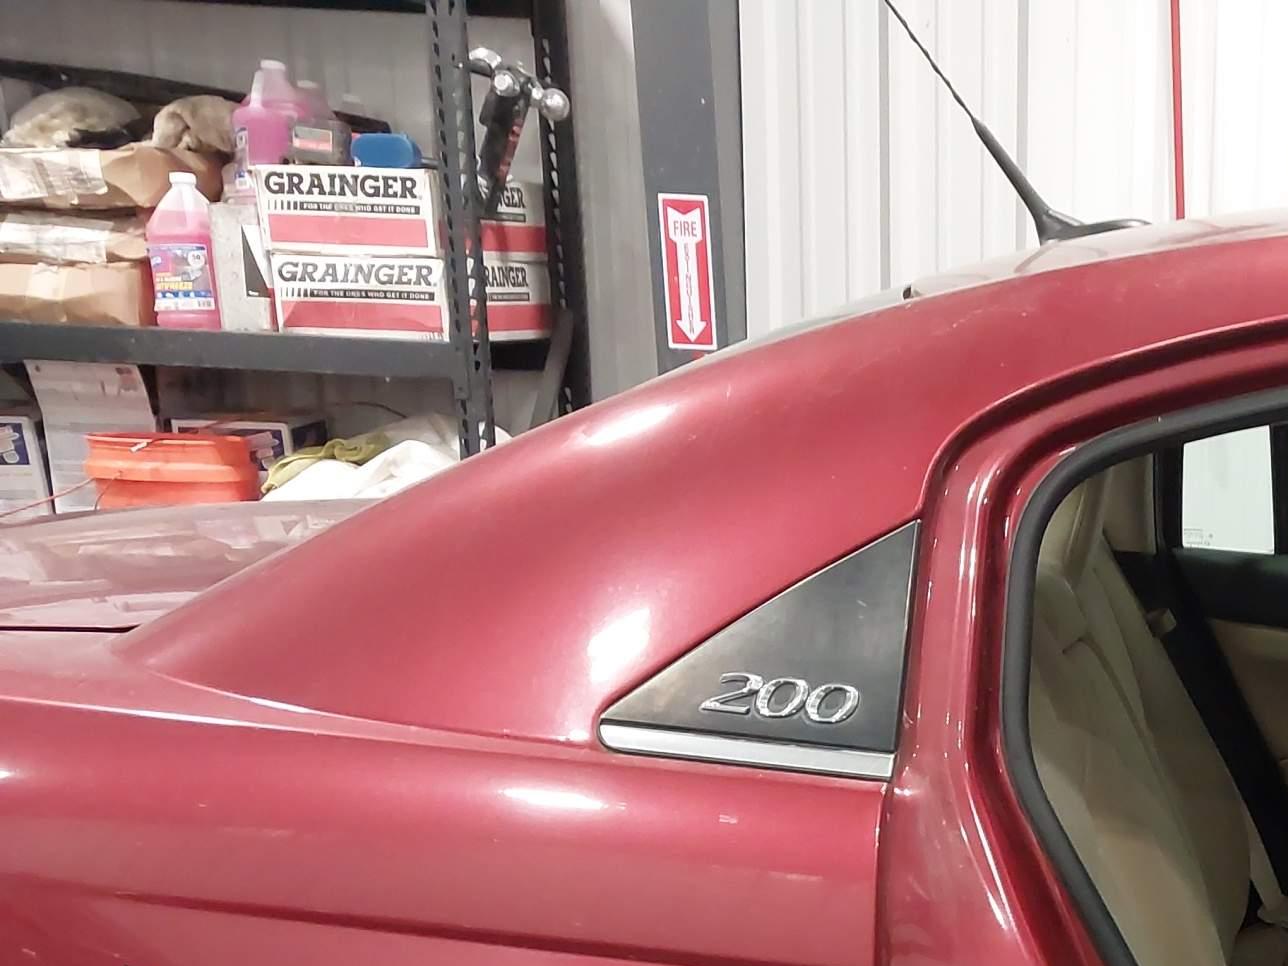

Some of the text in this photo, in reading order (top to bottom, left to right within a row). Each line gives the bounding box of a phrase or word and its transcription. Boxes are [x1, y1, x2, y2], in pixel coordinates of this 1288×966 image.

[264, 171, 417, 199] GRAINGER
[673, 220, 698, 237] FIRE
[277, 261, 433, 287] GRAINGER
[485, 265, 529, 288] RAINGER
[699, 672, 860, 724] 200
